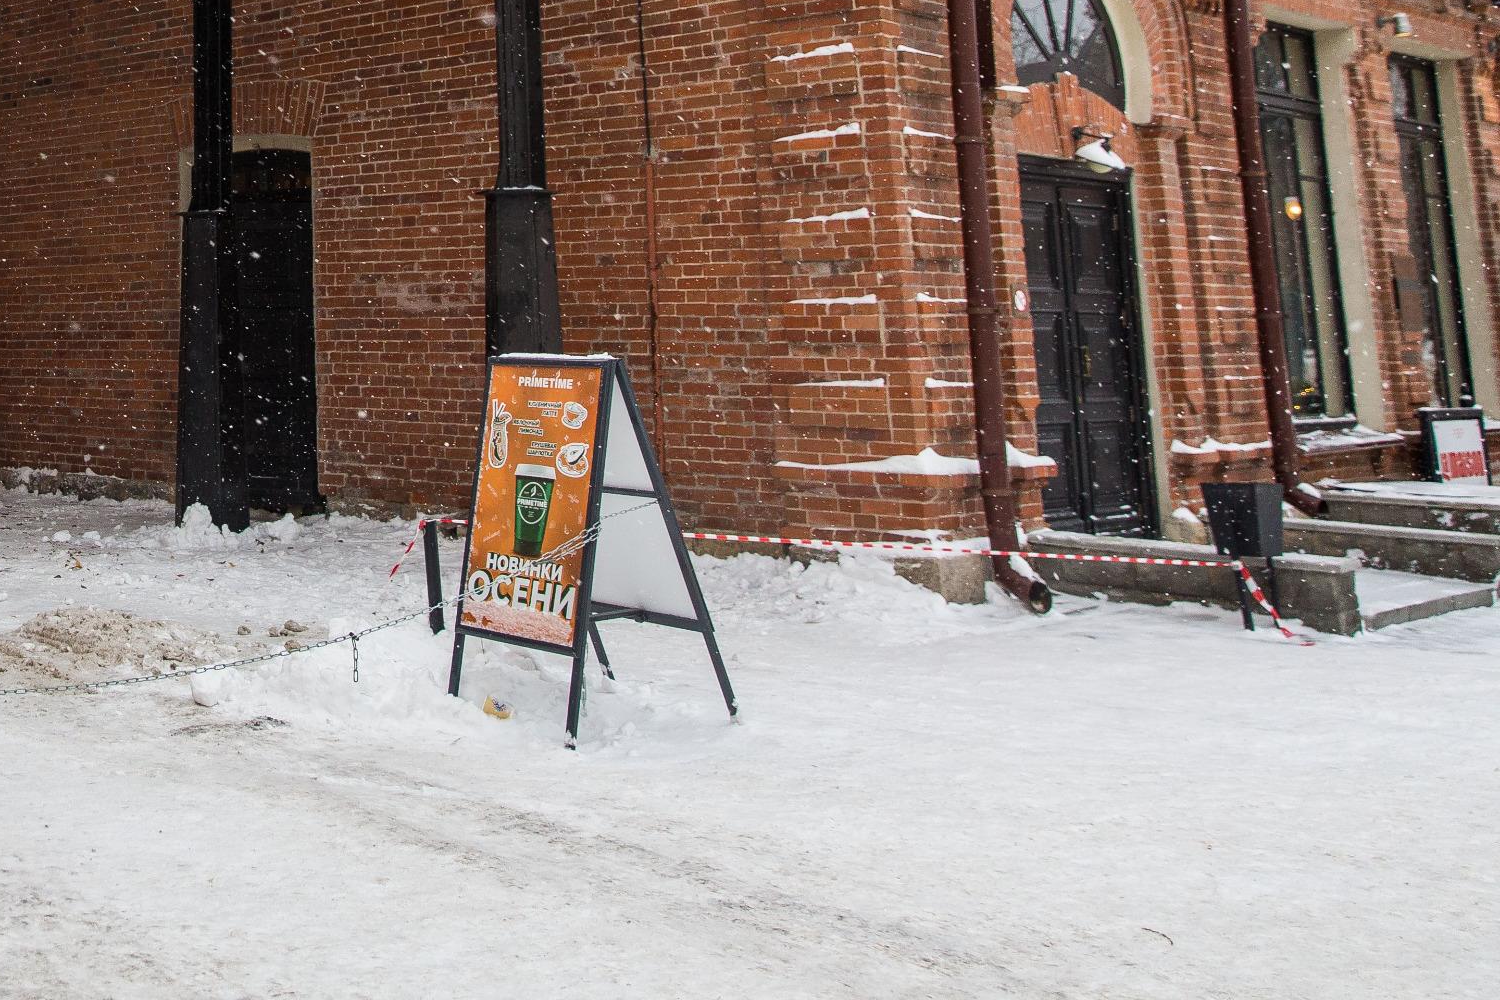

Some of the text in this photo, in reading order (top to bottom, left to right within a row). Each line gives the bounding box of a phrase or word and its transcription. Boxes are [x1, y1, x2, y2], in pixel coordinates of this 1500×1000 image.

[518, 373, 574, 390] PRIMETIME
[517, 498, 548, 508] PRIMETIME
[486, 552, 563, 582] НОВИНКИ
[467, 569, 576, 620] ОСЕНИ
